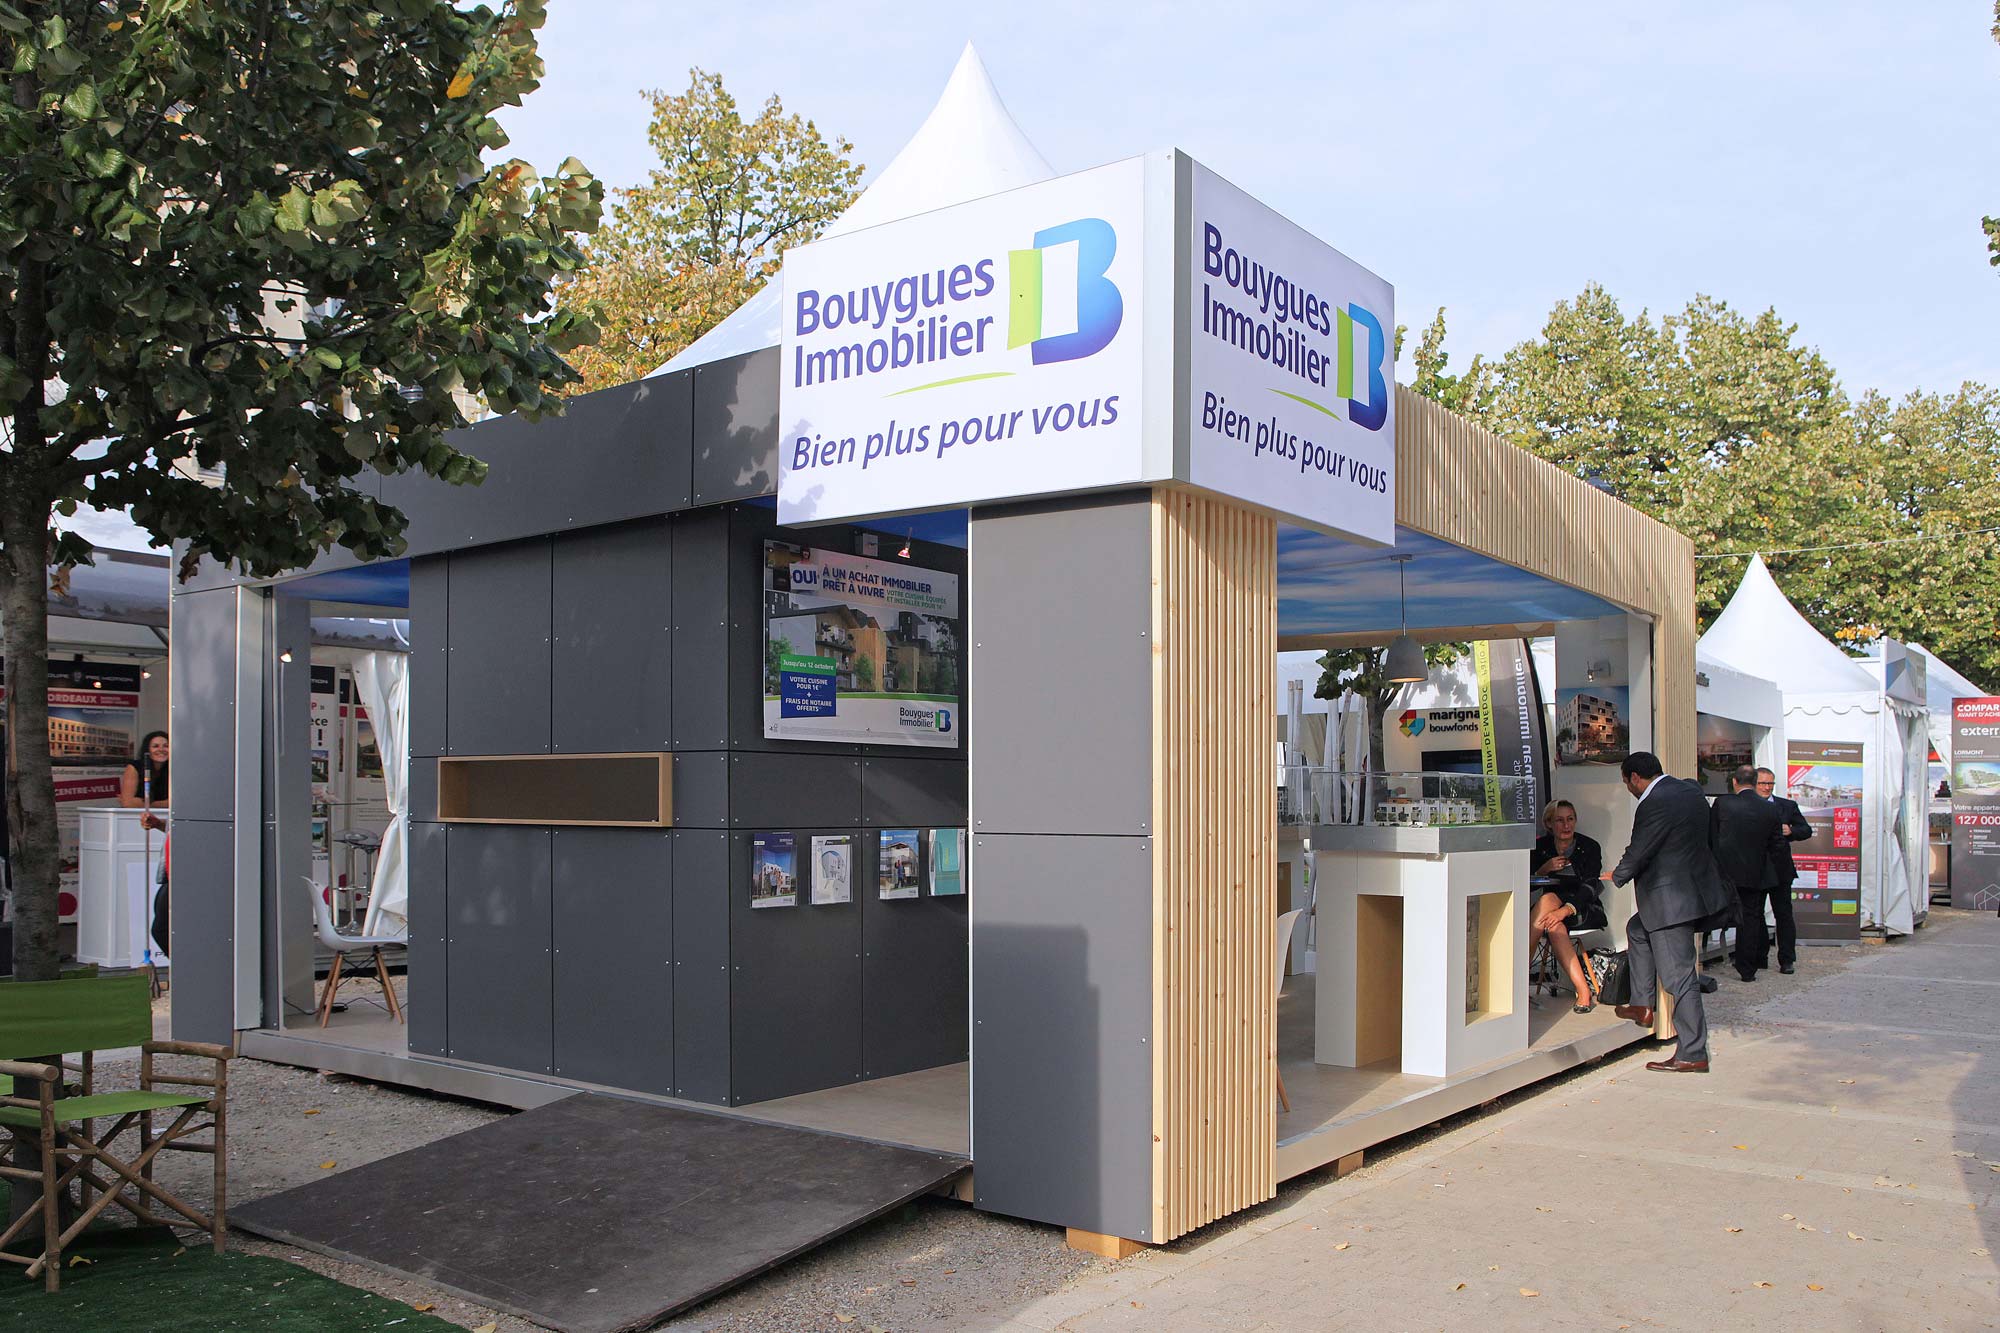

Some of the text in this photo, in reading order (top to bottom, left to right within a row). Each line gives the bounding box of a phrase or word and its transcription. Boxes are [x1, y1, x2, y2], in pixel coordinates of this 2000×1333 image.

[1204, 220, 1331, 336] Bouygues
[796, 258, 995, 336] Bouygues
[1203, 283, 1331, 388] Immobilier
[795, 315, 993, 388] Immobilier
[791, 394, 1120, 471] Bien plus pour vous
[1202, 391, 1387, 494] Bien plus pour vous
[792, 570, 817, 585] OUI
[822, 567, 932, 594] À UN ACHAT IMMOBILIER
[823, 578, 884, 598] PRÊT À VIVRE
[905, 592, 924, 601] CUISINE
[784, 660, 807, 668] Jusqu'au
[900, 707, 934, 719] Bouygues
[1957, 703, 2000, 712] COMPAR
[1430, 708, 1480, 722] marigna
[900, 718, 934, 728] Immobilier
[1430, 722, 1479, 733] bouwfonds
[1960, 727, 2000, 736] exterr
[1958, 816, 1977, 825] 127
